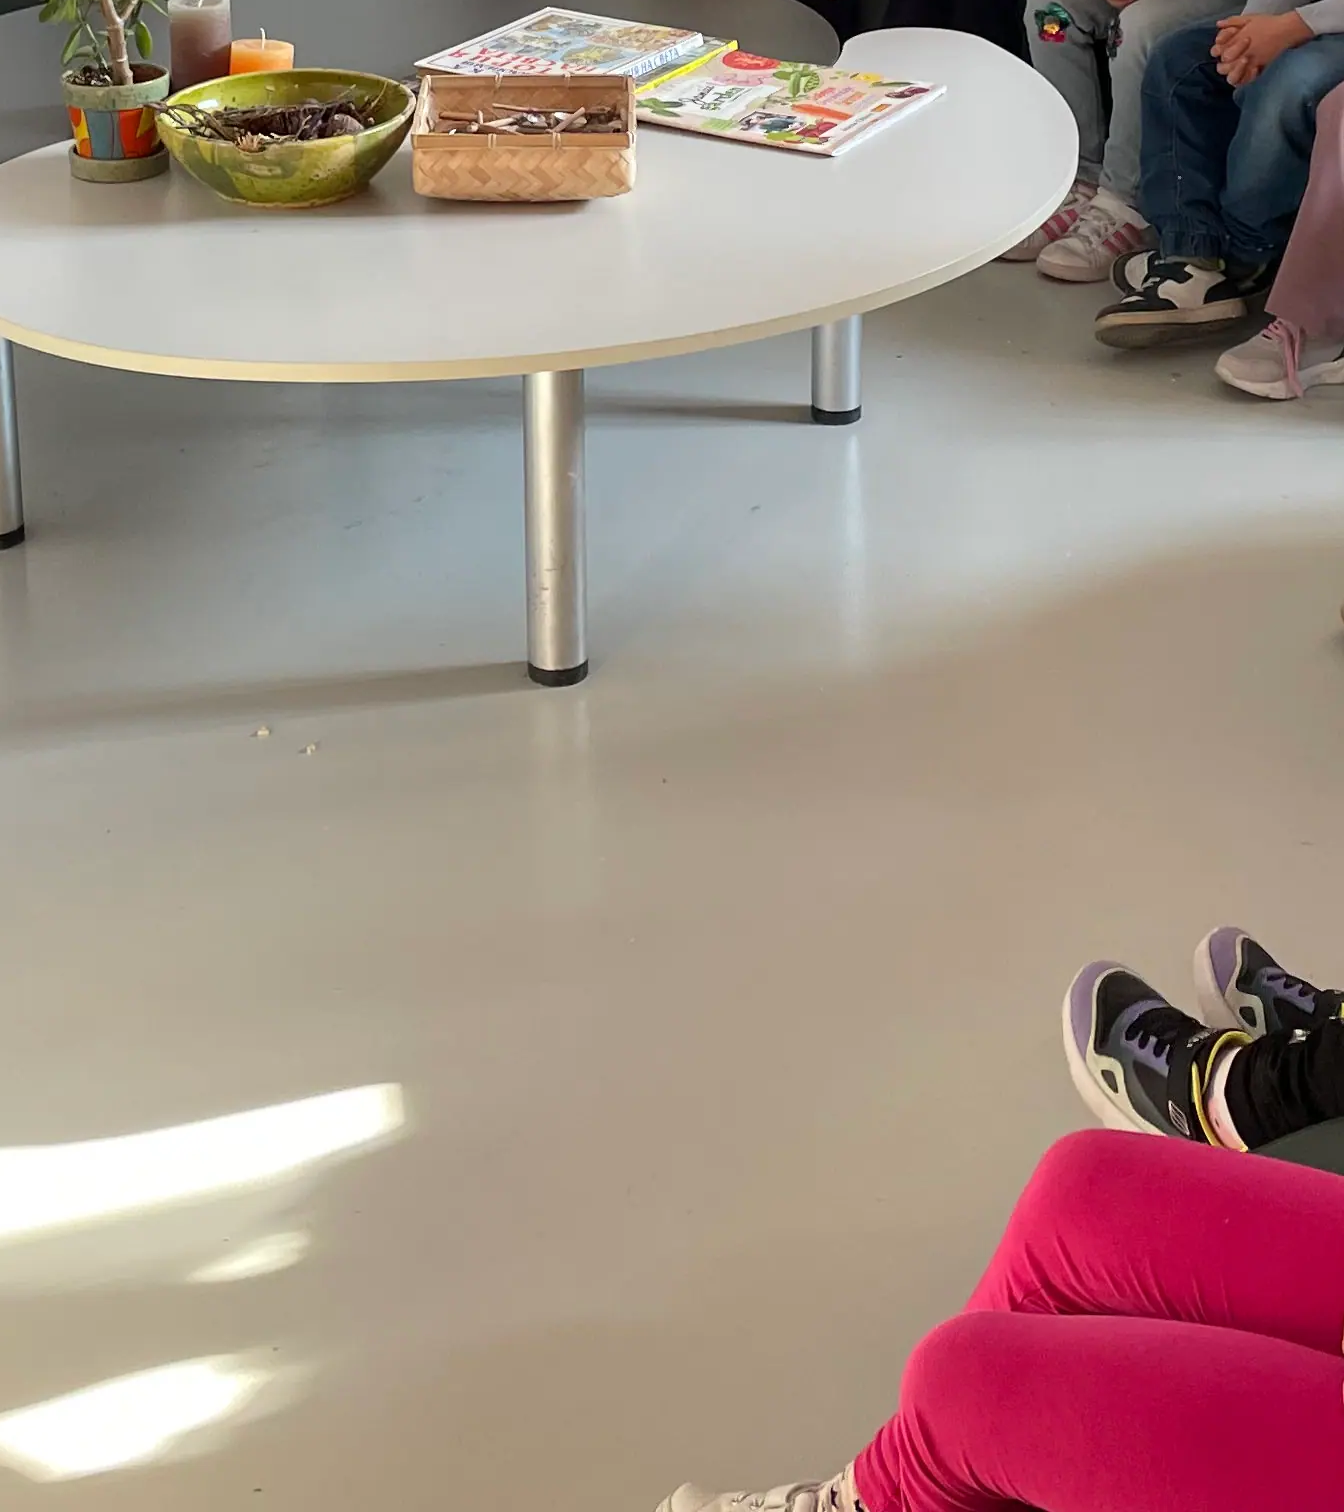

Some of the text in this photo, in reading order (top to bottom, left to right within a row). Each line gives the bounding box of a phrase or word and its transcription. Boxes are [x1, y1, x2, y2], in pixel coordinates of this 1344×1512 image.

[448, 50, 552, 75] ТОРИЯ
[640, 59, 653, 73] НА
[654, 47, 680, 67] СВЕТА
